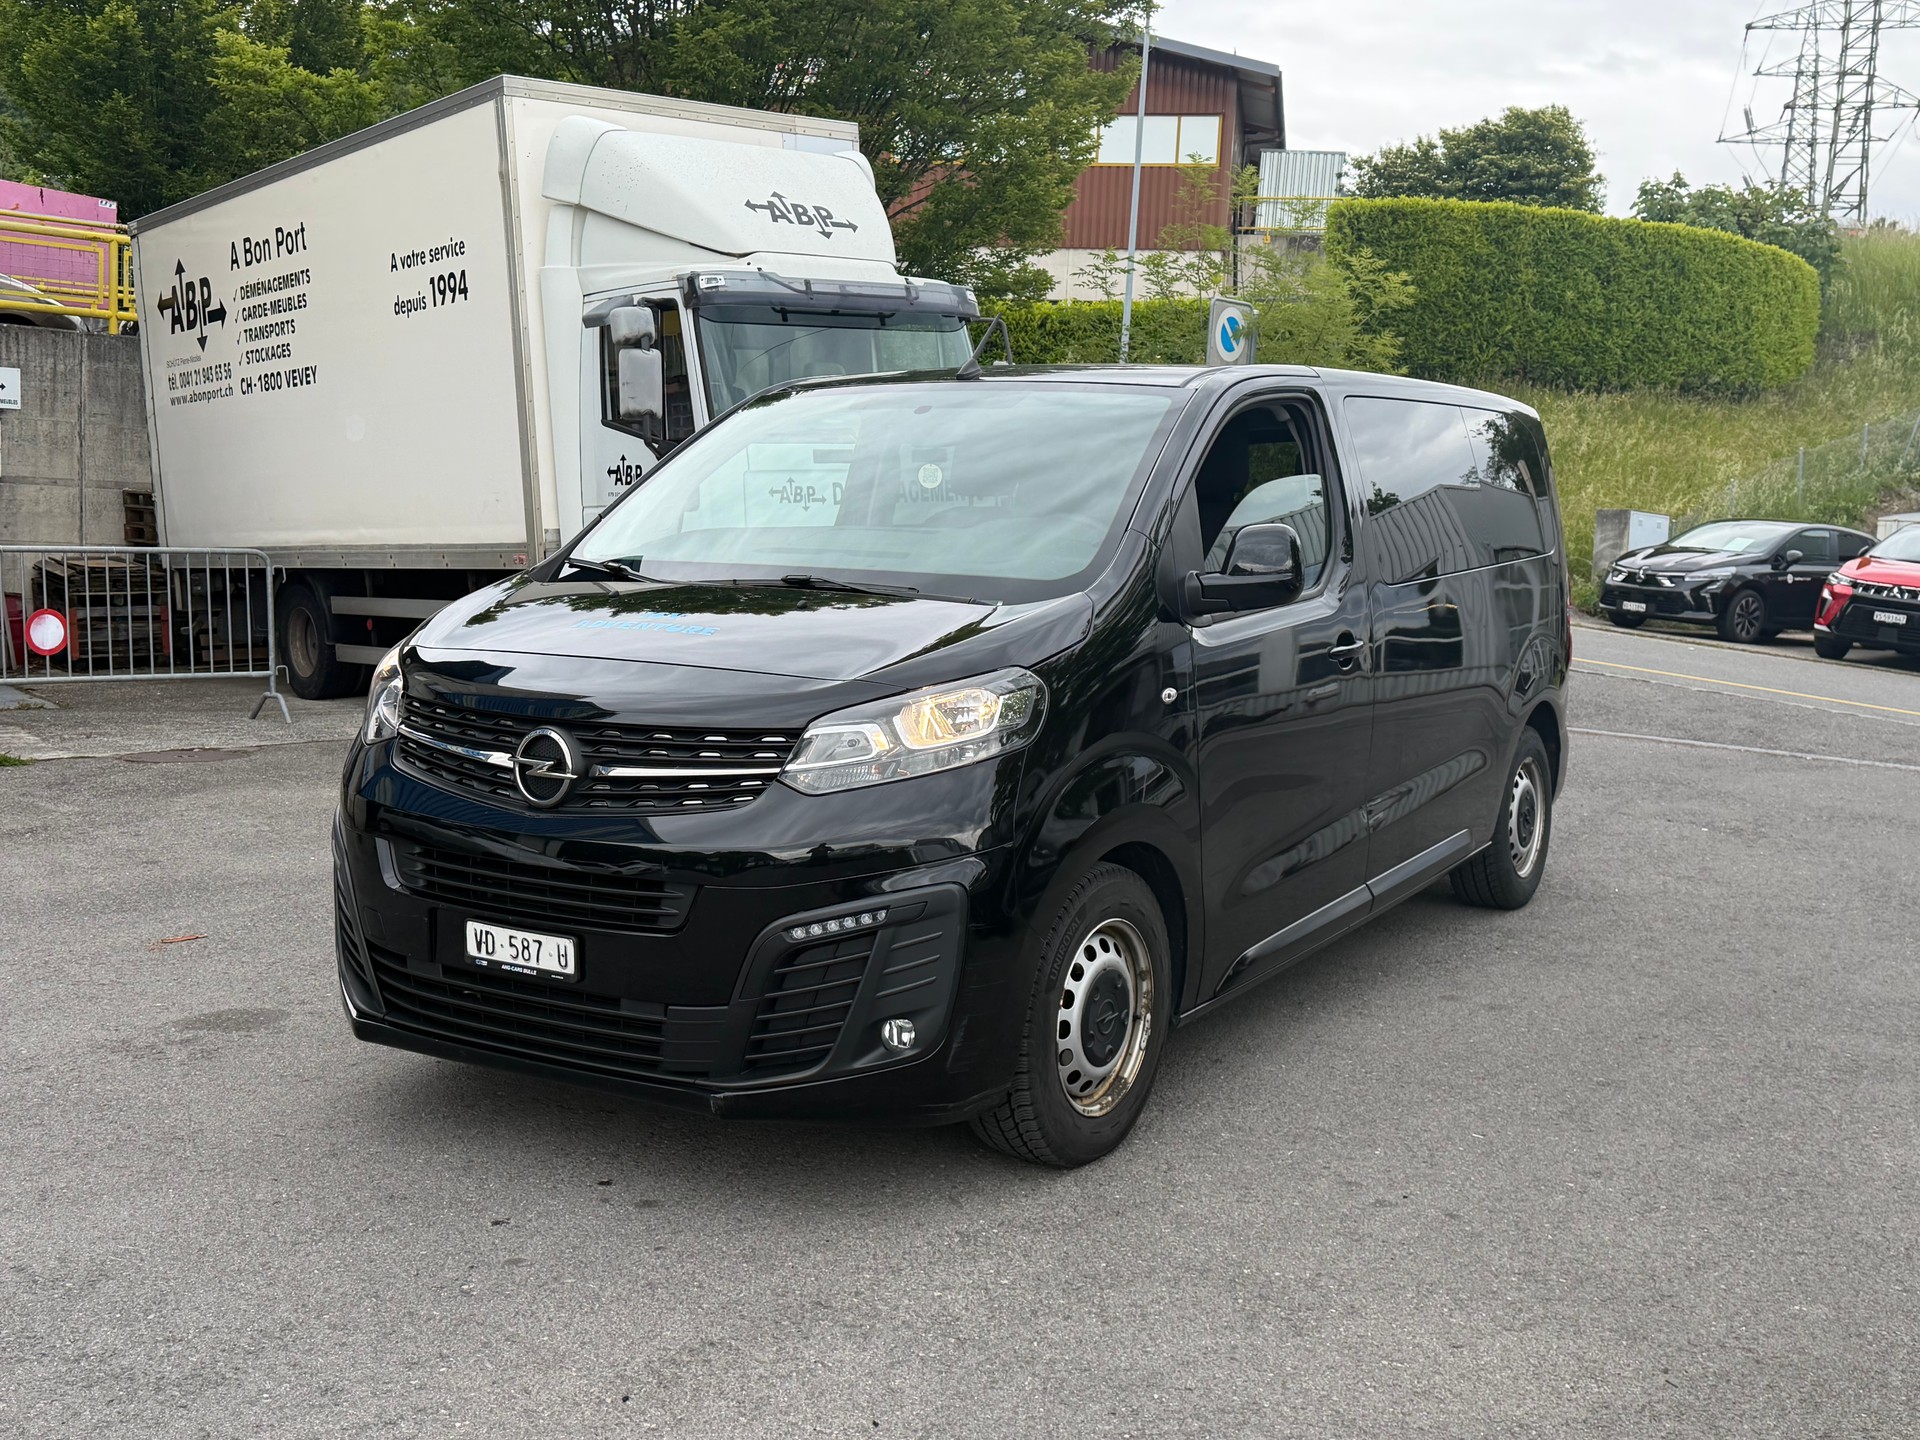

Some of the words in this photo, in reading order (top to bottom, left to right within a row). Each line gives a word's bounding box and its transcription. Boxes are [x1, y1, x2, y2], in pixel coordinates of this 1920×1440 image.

[767, 200, 834, 228] ABP
[230, 241, 240, 271] A
[243, 237, 271, 267] Bon
[275, 222, 307, 258] Port
[390, 253, 398, 272] A
[400, 249, 426, 269] votre
[429, 237, 466, 263] service
[240, 268, 311, 300] DÉMÉNAGEMENTS
[394, 291, 427, 318] depuis
[429, 269, 469, 307] 1994
[242, 293, 307, 322] GARDE-MEUBLES
[244, 319, 295, 343] TRANSPORTS
[245, 343, 291, 365] STOCKAGES
[168, 373, 179, 391] tél.
[179, 370, 194, 389] 0041
[194, 368, 201, 386] 21
[202, 365, 213, 384] 943
[215, 363, 222, 381] 63
[223, 362, 232, 380] 56
[284, 365, 317, 388] VEVEY
[170, 383, 234, 407] www.abonport.ch
[615, 464, 643, 486] ABP
[779, 485, 816, 504] ABP
[572, 619, 721, 636] ADVENTURE
[473, 927, 496, 957] VD
[509, 935, 543, 966] 587
[556, 942, 568, 970] U
[1050, 915, 1082, 980] UNIROYAL
